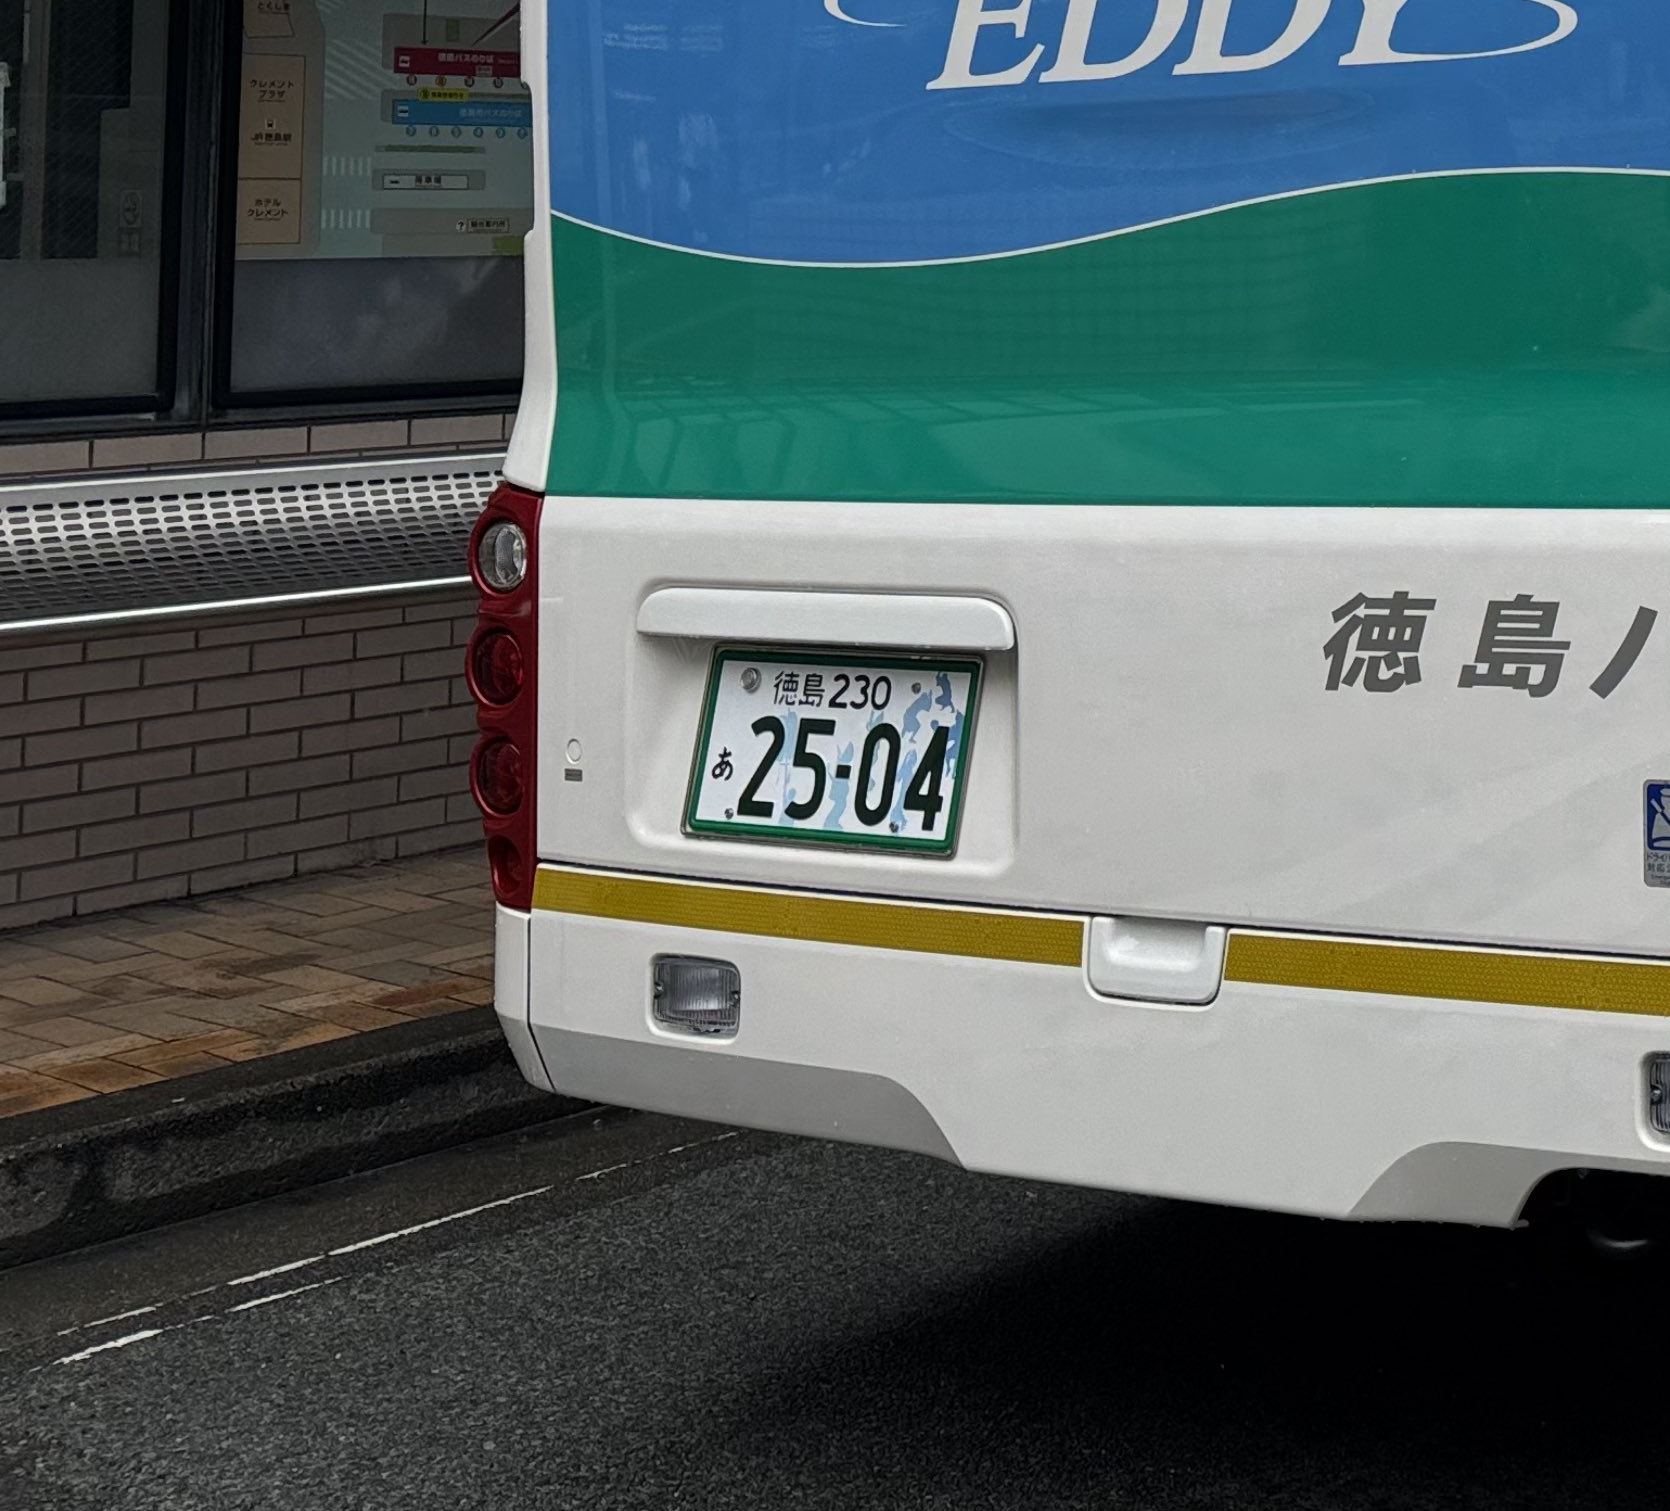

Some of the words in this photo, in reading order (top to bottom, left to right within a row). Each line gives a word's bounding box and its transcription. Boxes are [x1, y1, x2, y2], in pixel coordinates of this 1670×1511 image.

[250, 78, 295, 89] クレメント
[254, 197, 282, 208] ホテル
[247, 208, 289, 219] クレメント
[773, 671, 824, 709] 徳島
[827, 673, 892, 711] 230
[710, 747, 734, 782] あ
[736, 714, 951, 832] 25-04
